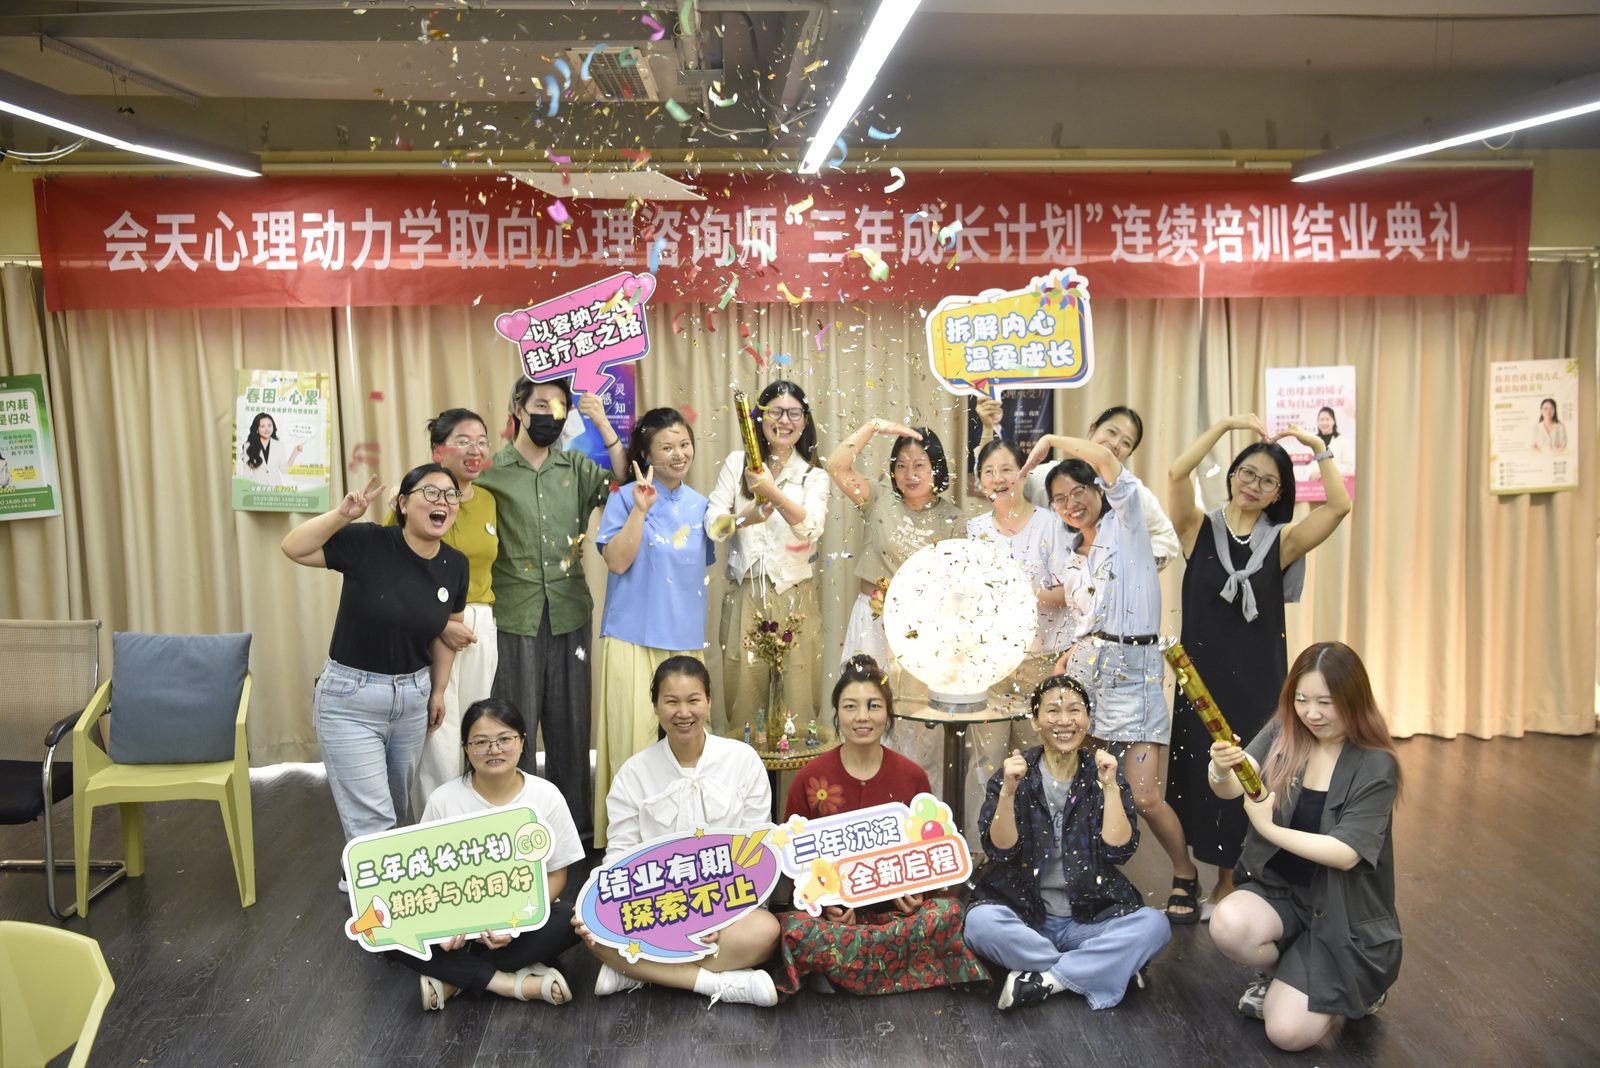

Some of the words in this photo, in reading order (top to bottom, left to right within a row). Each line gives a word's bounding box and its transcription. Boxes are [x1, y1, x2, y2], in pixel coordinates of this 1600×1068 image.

[524, 314, 643, 375] 赴疗愈之路
[945, 309, 1056, 344] 拆解内心
[964, 340, 1075, 372] 温柔成长
[246, 388, 276, 403] 春困
[289, 390, 319, 405] 心累
[355, 832, 513, 889] 三年成长计划
[517, 829, 547, 854] GO
[792, 816, 902, 864] 三年沉淀
[389, 865, 535, 920] 期待与你同行
[597, 843, 733, 902] 结业有期
[850, 843, 961, 894] 全新启程
[620, 874, 758, 934] 探索不止
